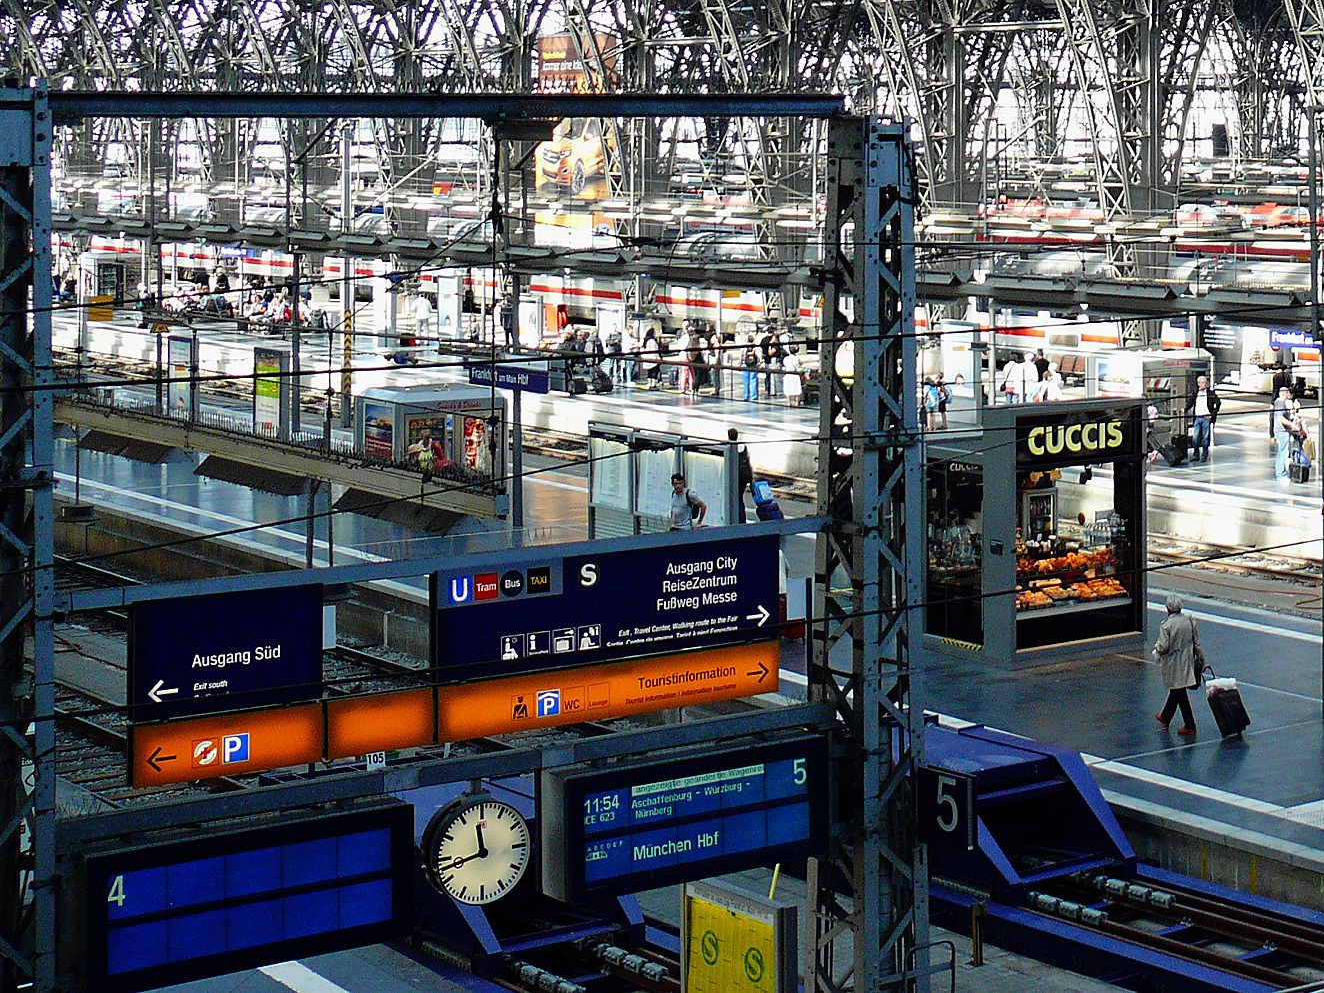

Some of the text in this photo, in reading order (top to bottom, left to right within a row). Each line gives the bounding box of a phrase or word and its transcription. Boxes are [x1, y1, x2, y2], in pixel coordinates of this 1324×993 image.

[1028, 418, 1124, 456] CUCCIS
[666, 556, 738, 576] Ausgang City
[452, 563, 598, 603] U Tram Bus TAXI S
[662, 573, 738, 593] ReiseZentrum
[656, 591, 738, 611] Fußweg Messe
[634, 626, 651, 635] Travel
[672, 621, 694, 631] Walking
[695, 618, 710, 627] route
[710, 616, 717, 625] to
[717, 615, 727, 624] the
[727, 615, 738, 623] Fair
[191, 645, 282, 669] Ausgang Süd
[193, 679, 229, 691] Exit south
[637, 666, 737, 690] Touristinformation
[542, 697, 556, 716] P
[564, 699, 580, 710] WC
[645, 692, 677, 702] information
[224, 736, 243, 759] P
[366, 752, 385, 765] 105
[792, 758, 808, 785] 5
[584, 794, 620, 814] 11:54
[631, 792, 692, 809] Aschaffenburg
[936, 775, 959, 832] 5
[599, 811, 615, 822] 623
[633, 831, 719, 861] München Hbf
[107, 875, 126, 907] 4
